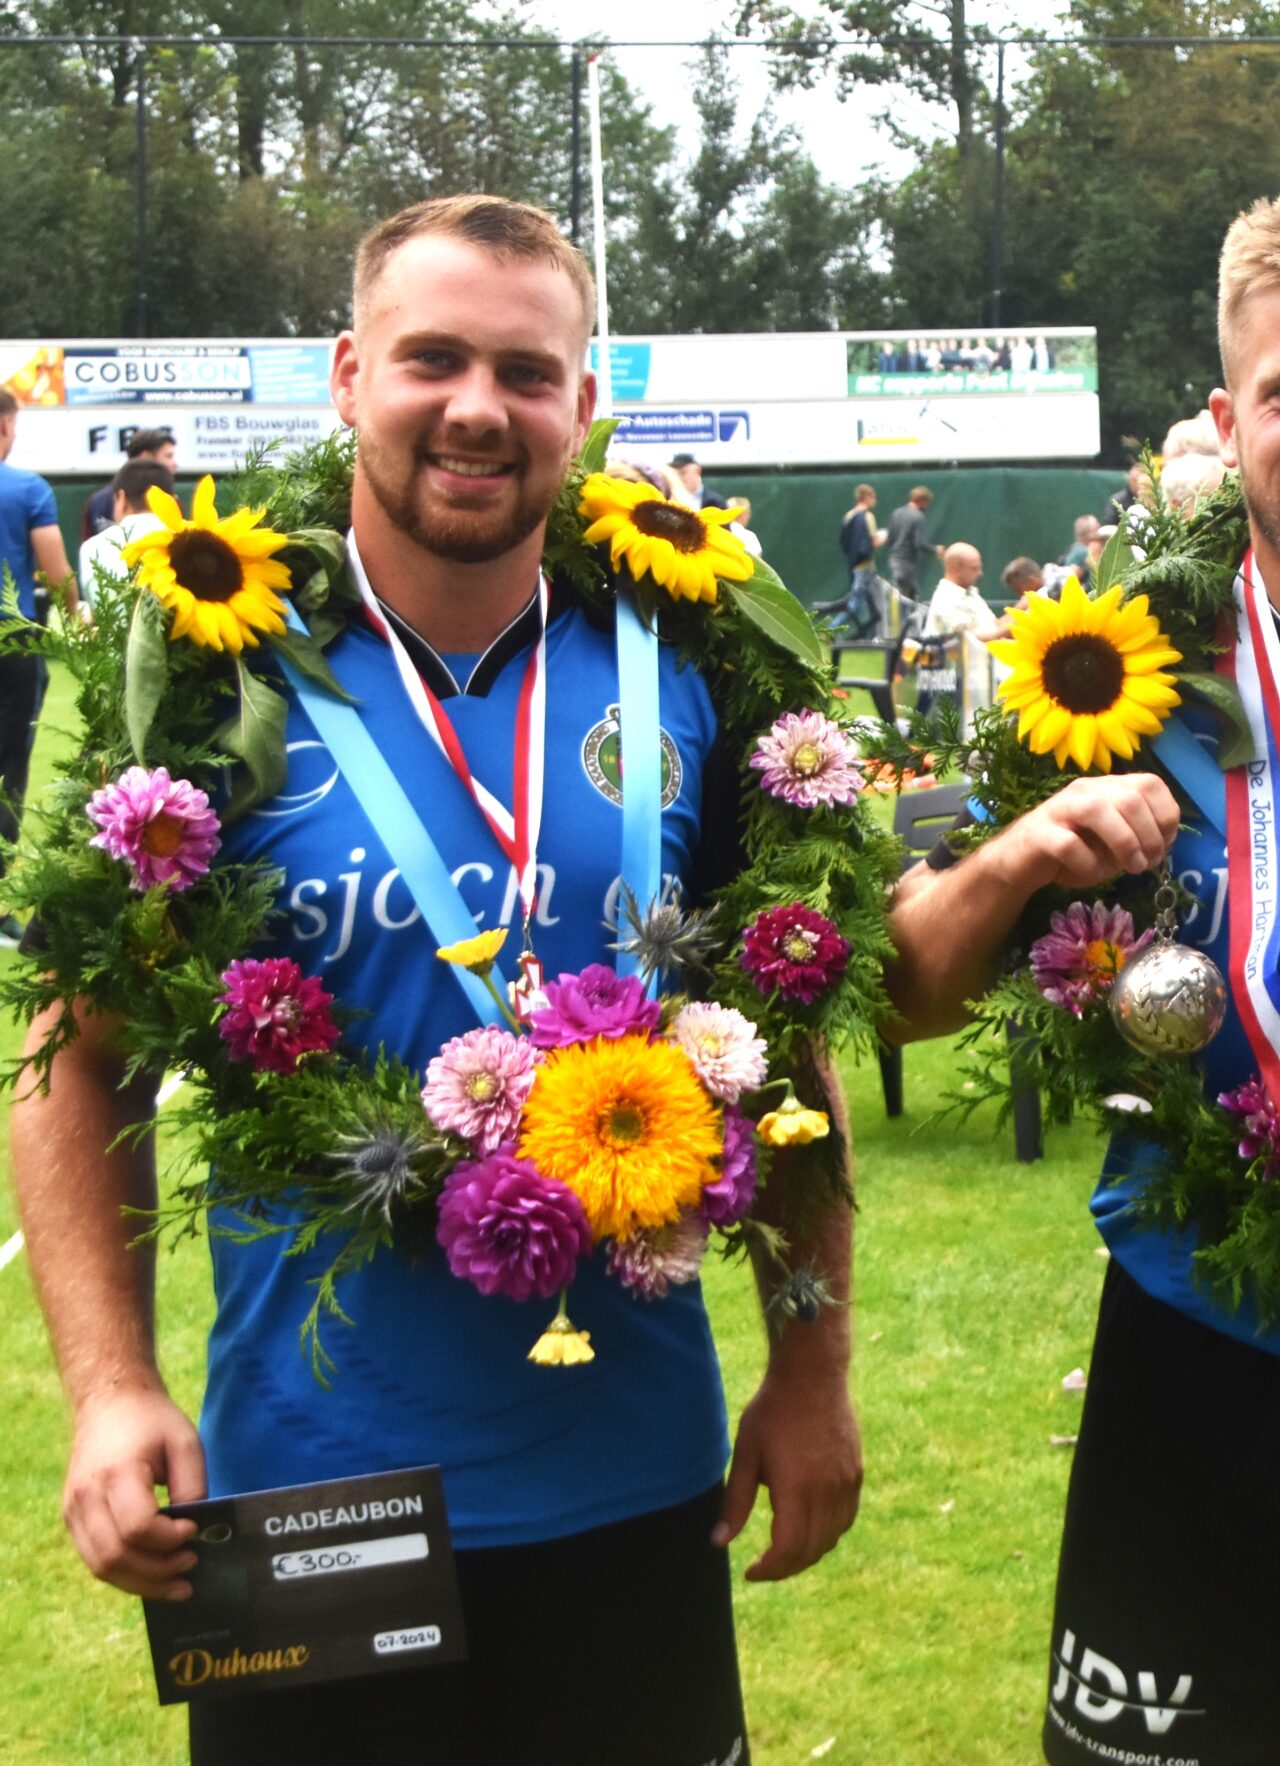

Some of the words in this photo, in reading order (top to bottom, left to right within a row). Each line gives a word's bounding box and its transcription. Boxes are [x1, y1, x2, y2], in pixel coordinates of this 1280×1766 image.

[194, 416, 230, 430] FBS
[235, 416, 320, 432] Bouwglas
[1249, 759, 1267, 789] De
[1251, 799, 1272, 891] Johannes
[250, 847, 560, 962] sjoch
[1247, 899, 1273, 980] Hartman
[264, 1495, 424, 1536] CADEAUBON
[169, 1645, 310, 1686] Duhoux
[1052, 1628, 1193, 1734] JDV
